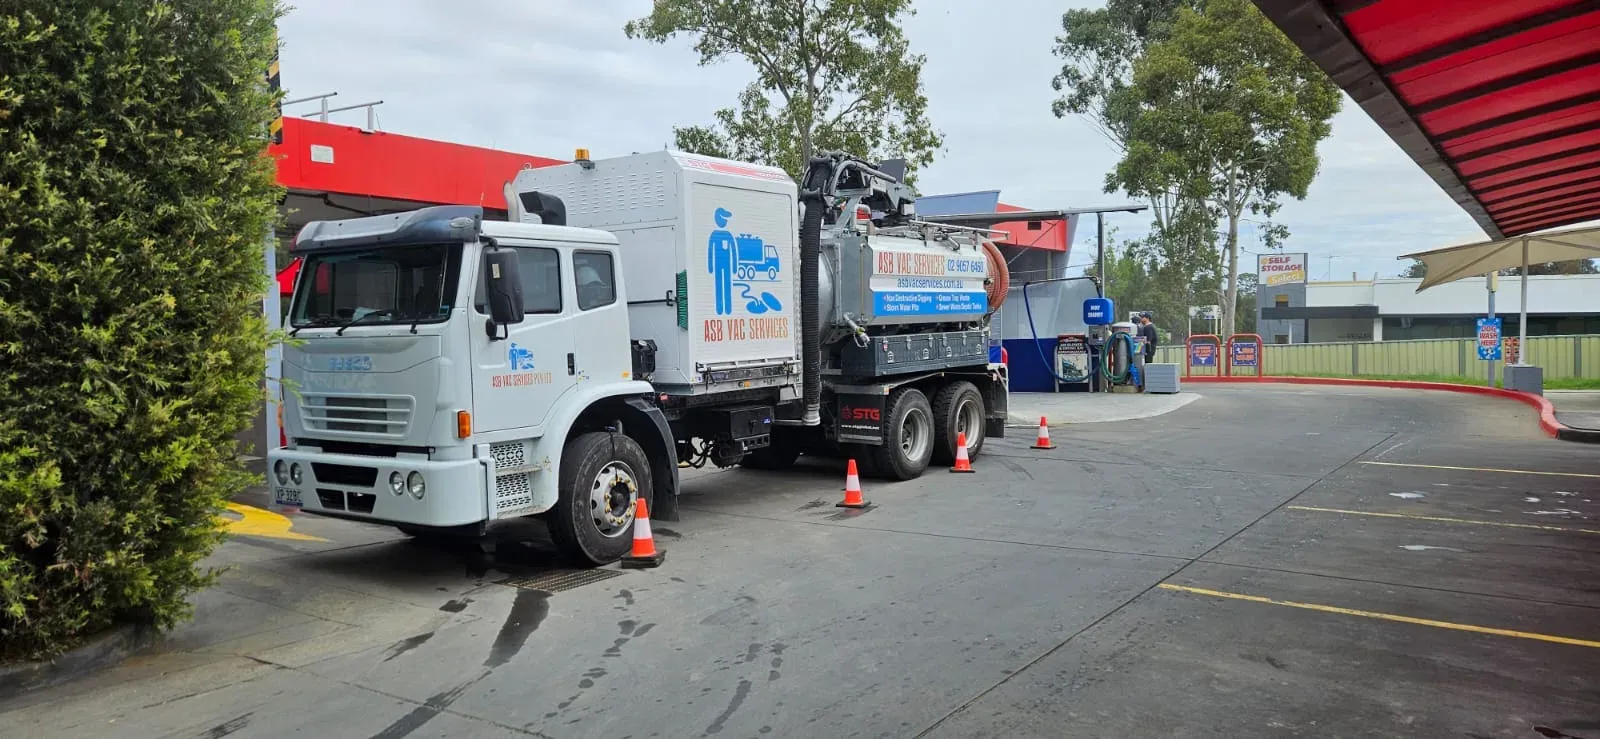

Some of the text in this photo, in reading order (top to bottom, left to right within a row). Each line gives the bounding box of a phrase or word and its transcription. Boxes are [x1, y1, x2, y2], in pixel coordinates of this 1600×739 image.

[878, 251, 945, 276] ASB VAC SERVICES
[947, 259, 954, 271] 02
[1268, 256, 1291, 264] SELF
[1261, 264, 1302, 272] STORAGE
[897, 278, 963, 289] asbvacservices.com.au
[704, 317, 789, 342] ASB VAC SERVICES
[492, 375, 502, 388] ASB
[503, 374, 512, 387] VAC
[513, 373, 533, 386] SERVICES
[853, 408, 880, 420] STG
